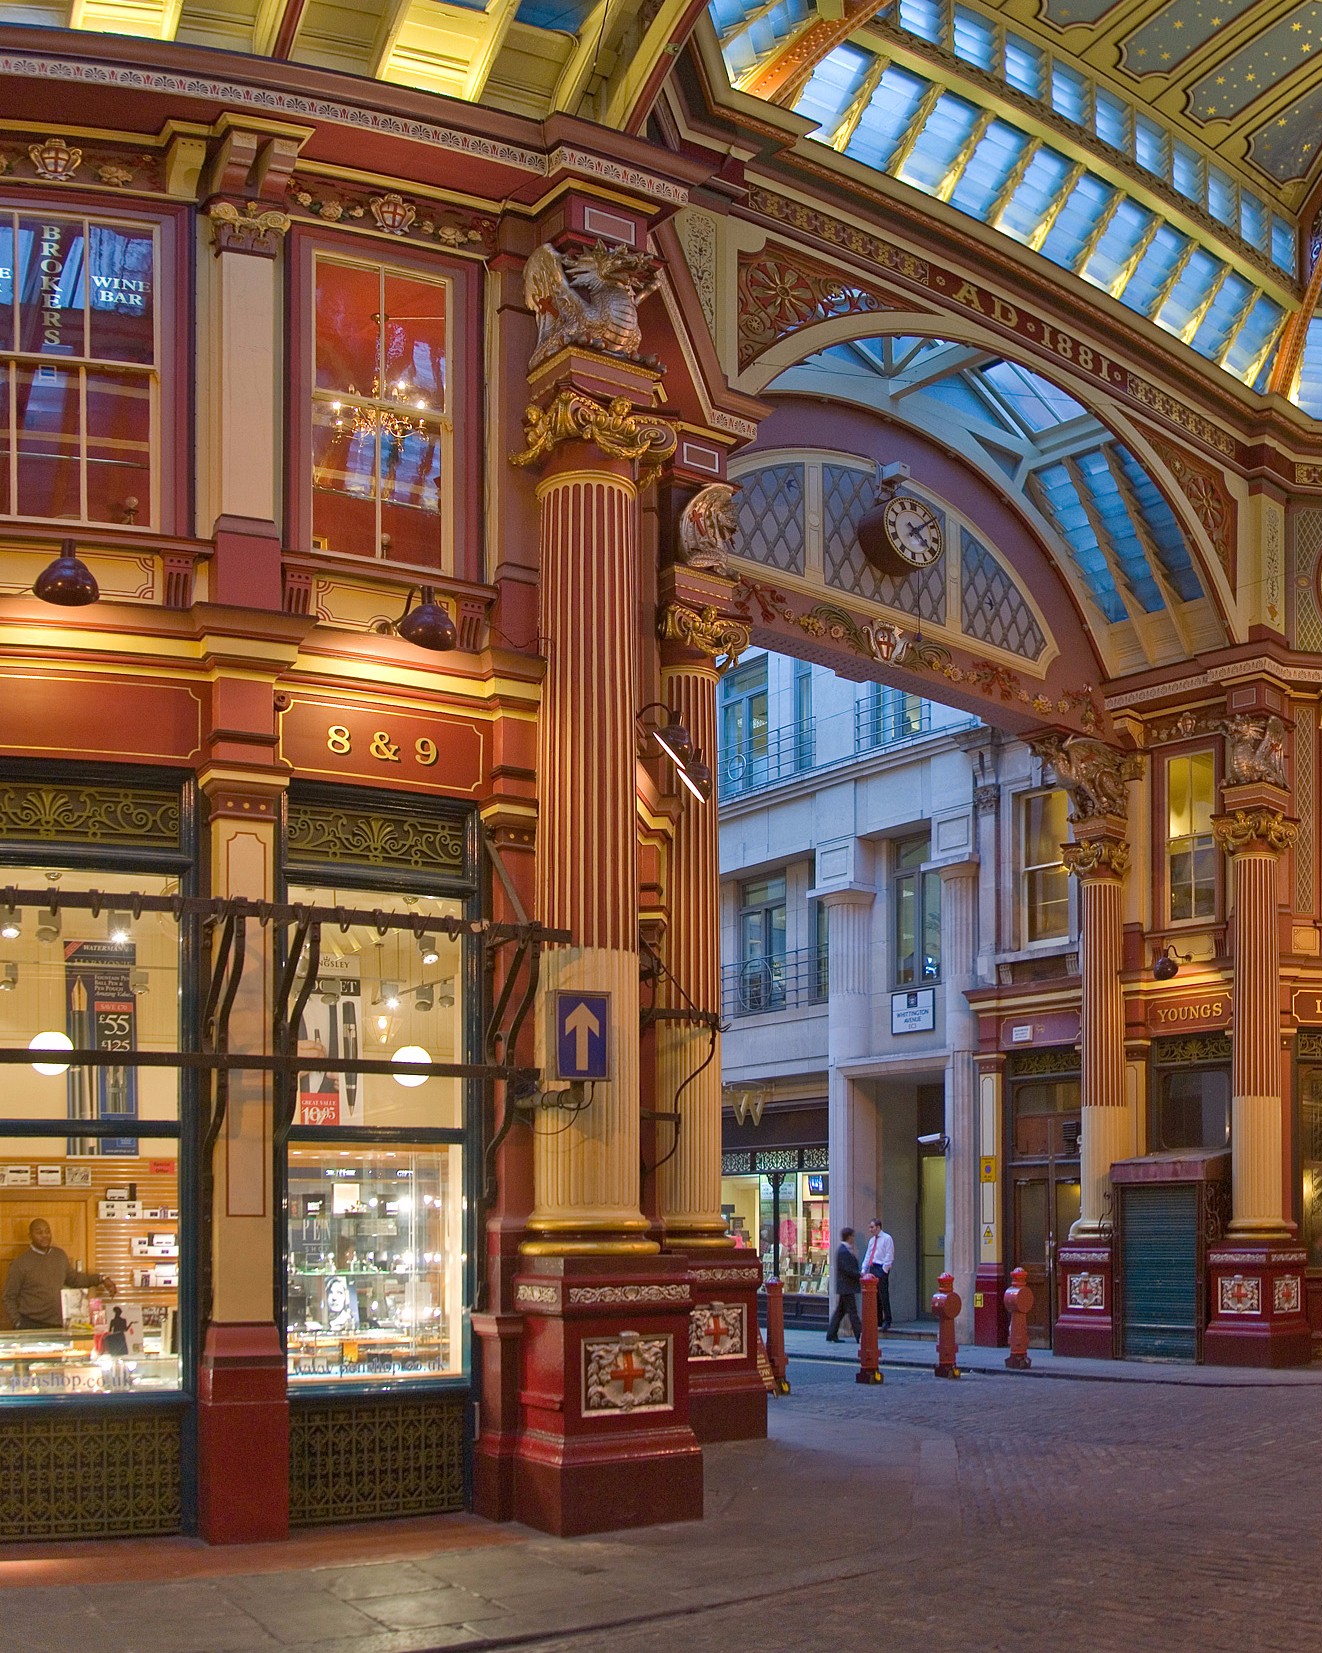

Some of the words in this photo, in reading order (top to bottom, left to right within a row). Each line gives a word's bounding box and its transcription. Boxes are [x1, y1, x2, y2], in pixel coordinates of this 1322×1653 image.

[40, 225, 63, 345] BROKERS
[91, 275, 151, 293] WINE
[100, 289, 143, 306] BAR
[1040, 323, 1111, 382] 1881
[327, 725, 351, 754] 8
[370, 731, 400, 761] &
[415, 737, 438, 766] 9
[318, 960, 350, 969] NGSLEY
[896, 1009, 930, 1018] WHITTINGTON
[1157, 1002, 1223, 1023] YOUNGS
[98, 1014, 130, 1035] £55
